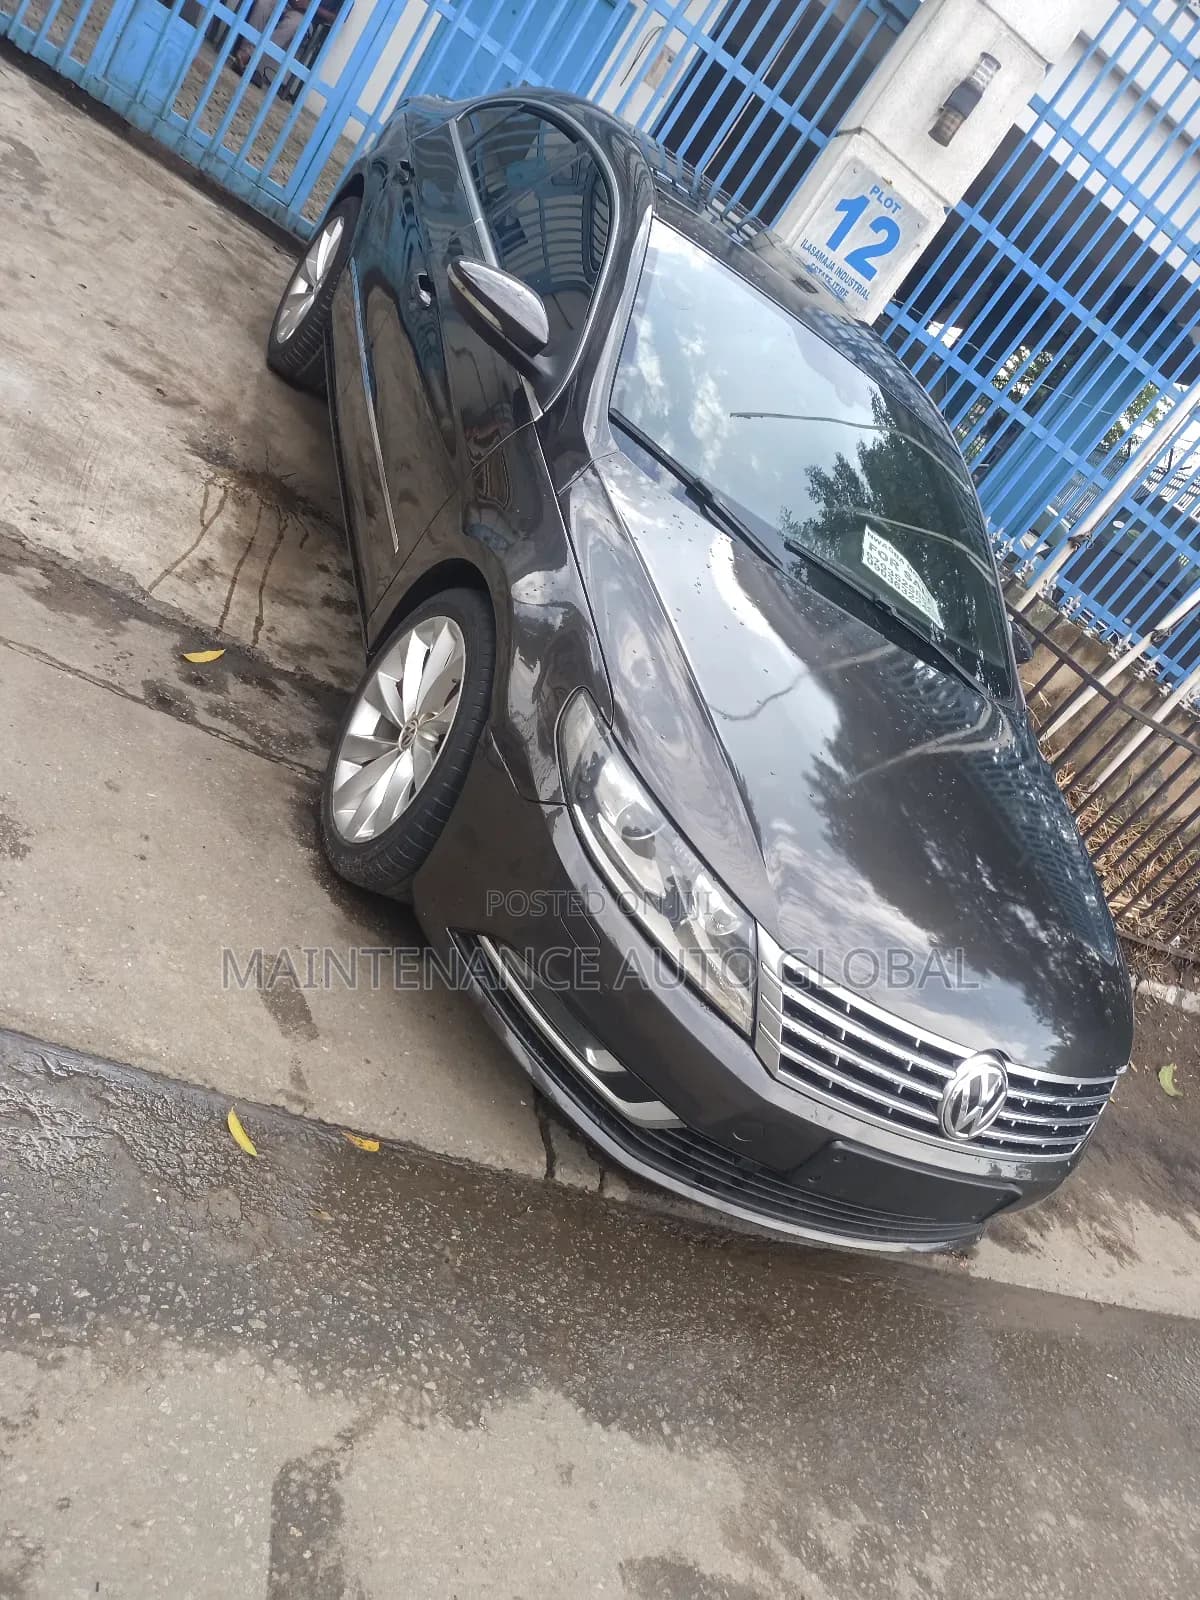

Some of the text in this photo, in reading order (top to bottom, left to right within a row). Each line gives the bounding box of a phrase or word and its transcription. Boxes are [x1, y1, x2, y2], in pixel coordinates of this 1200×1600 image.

[869, 184, 901, 214] PLOT
[825, 194, 901, 282] 12
[800, 238, 871, 300] ILASAMAJA INDUSTRIAL
[868, 542, 900, 571] FOR
